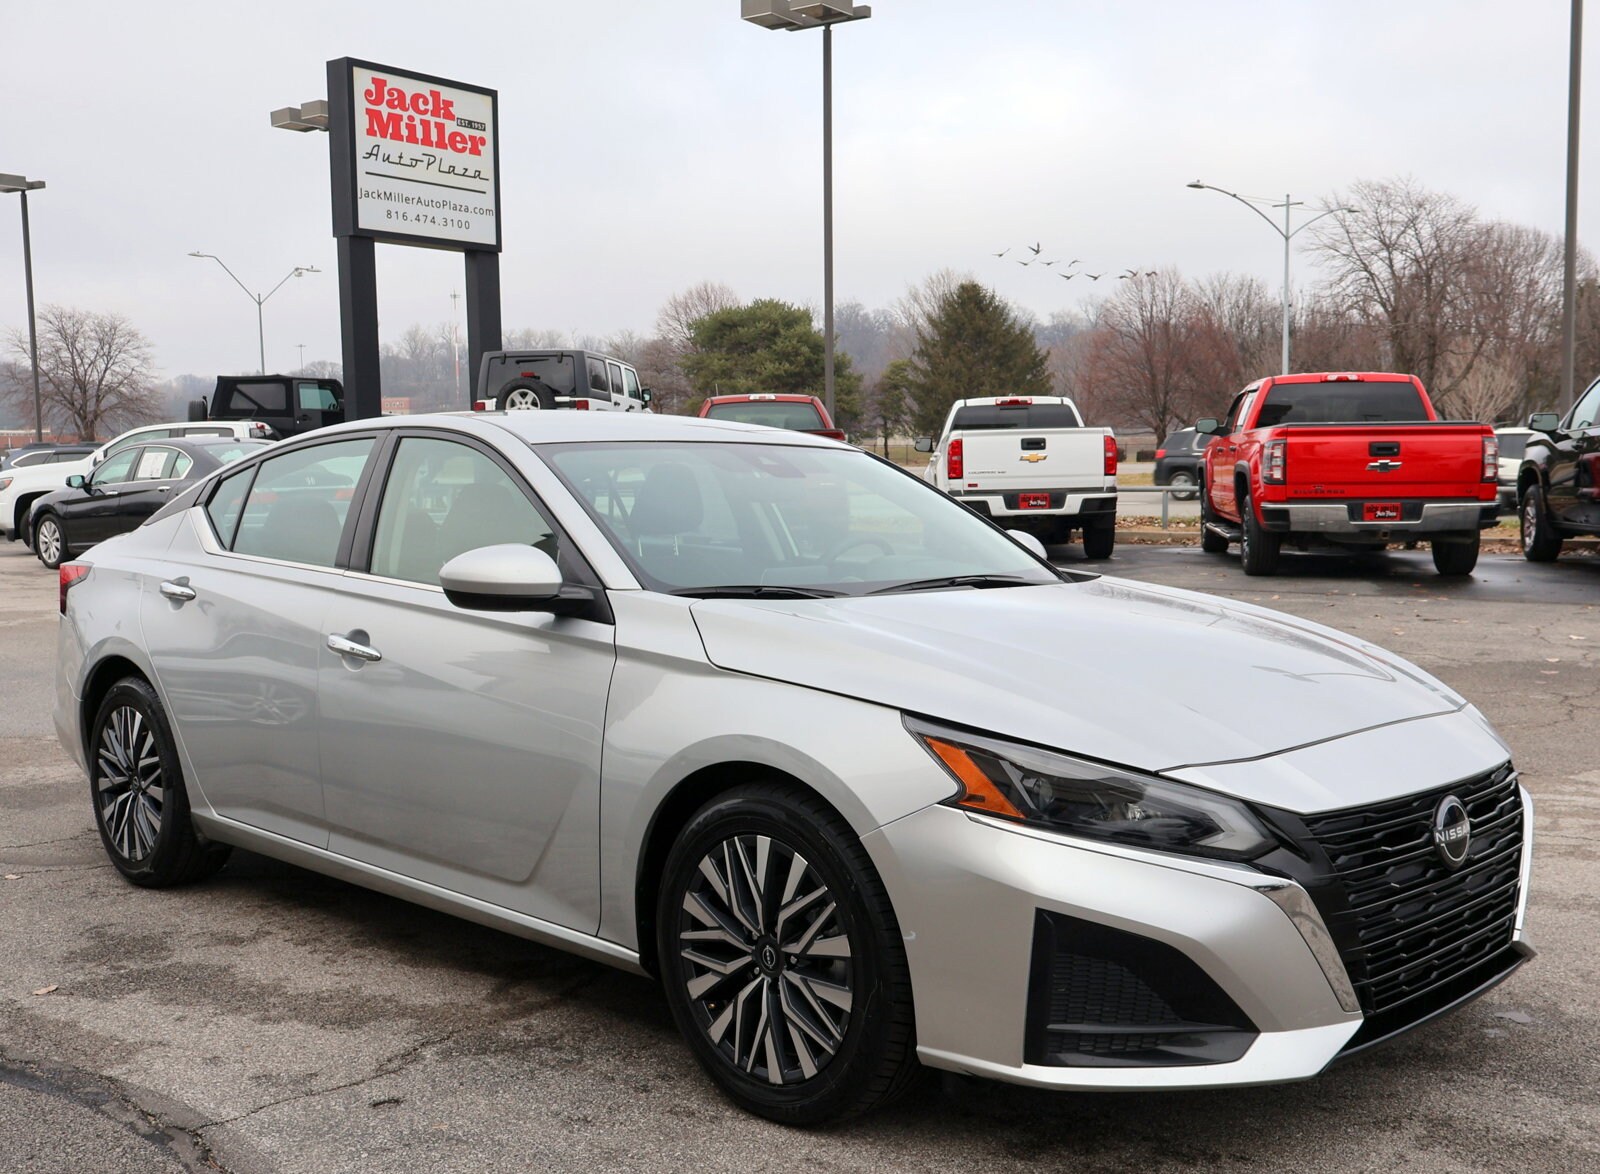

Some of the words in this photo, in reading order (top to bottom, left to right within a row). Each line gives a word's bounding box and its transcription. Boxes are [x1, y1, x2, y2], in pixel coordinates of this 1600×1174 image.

[364, 77, 455, 121] Jack
[366, 108, 486, 156] Miller
[359, 188, 493, 216] JackMillerAutoPlaza.com
[386, 210, 470, 229] 816.474.3100
